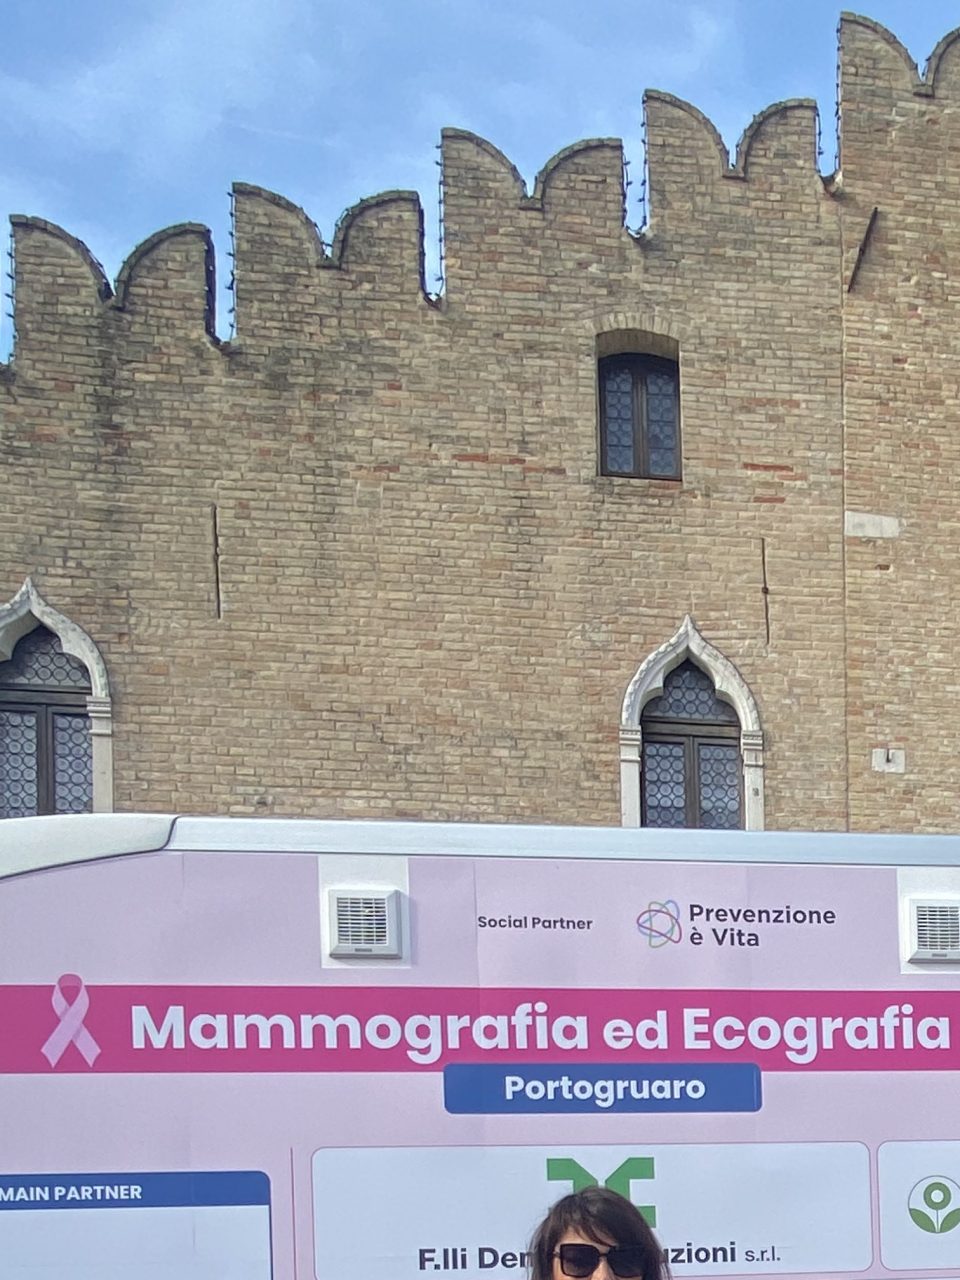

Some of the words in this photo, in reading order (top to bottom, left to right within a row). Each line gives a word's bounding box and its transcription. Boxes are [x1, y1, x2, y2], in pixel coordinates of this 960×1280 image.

[477, 914, 528, 930] Social
[531, 915, 593, 931] Partner
[689, 904, 837, 927] Prevenzione
[689, 927, 704, 946] è
[712, 928, 760, 948] Vita
[131, 1002, 589, 1065] Mammografia
[603, 1010, 668, 1050] ed
[683, 1003, 951, 1065] Ecografia
[504, 1074, 706, 1108] Portogruaro
[0, 1186, 49, 1202] MAIN
[54, 1184, 142, 1201] PARTNER
[418, 1247, 467, 1270] F.lli
[478, 1247, 536, 1270] Den
[744, 1245, 781, 1263] s.r.l.
